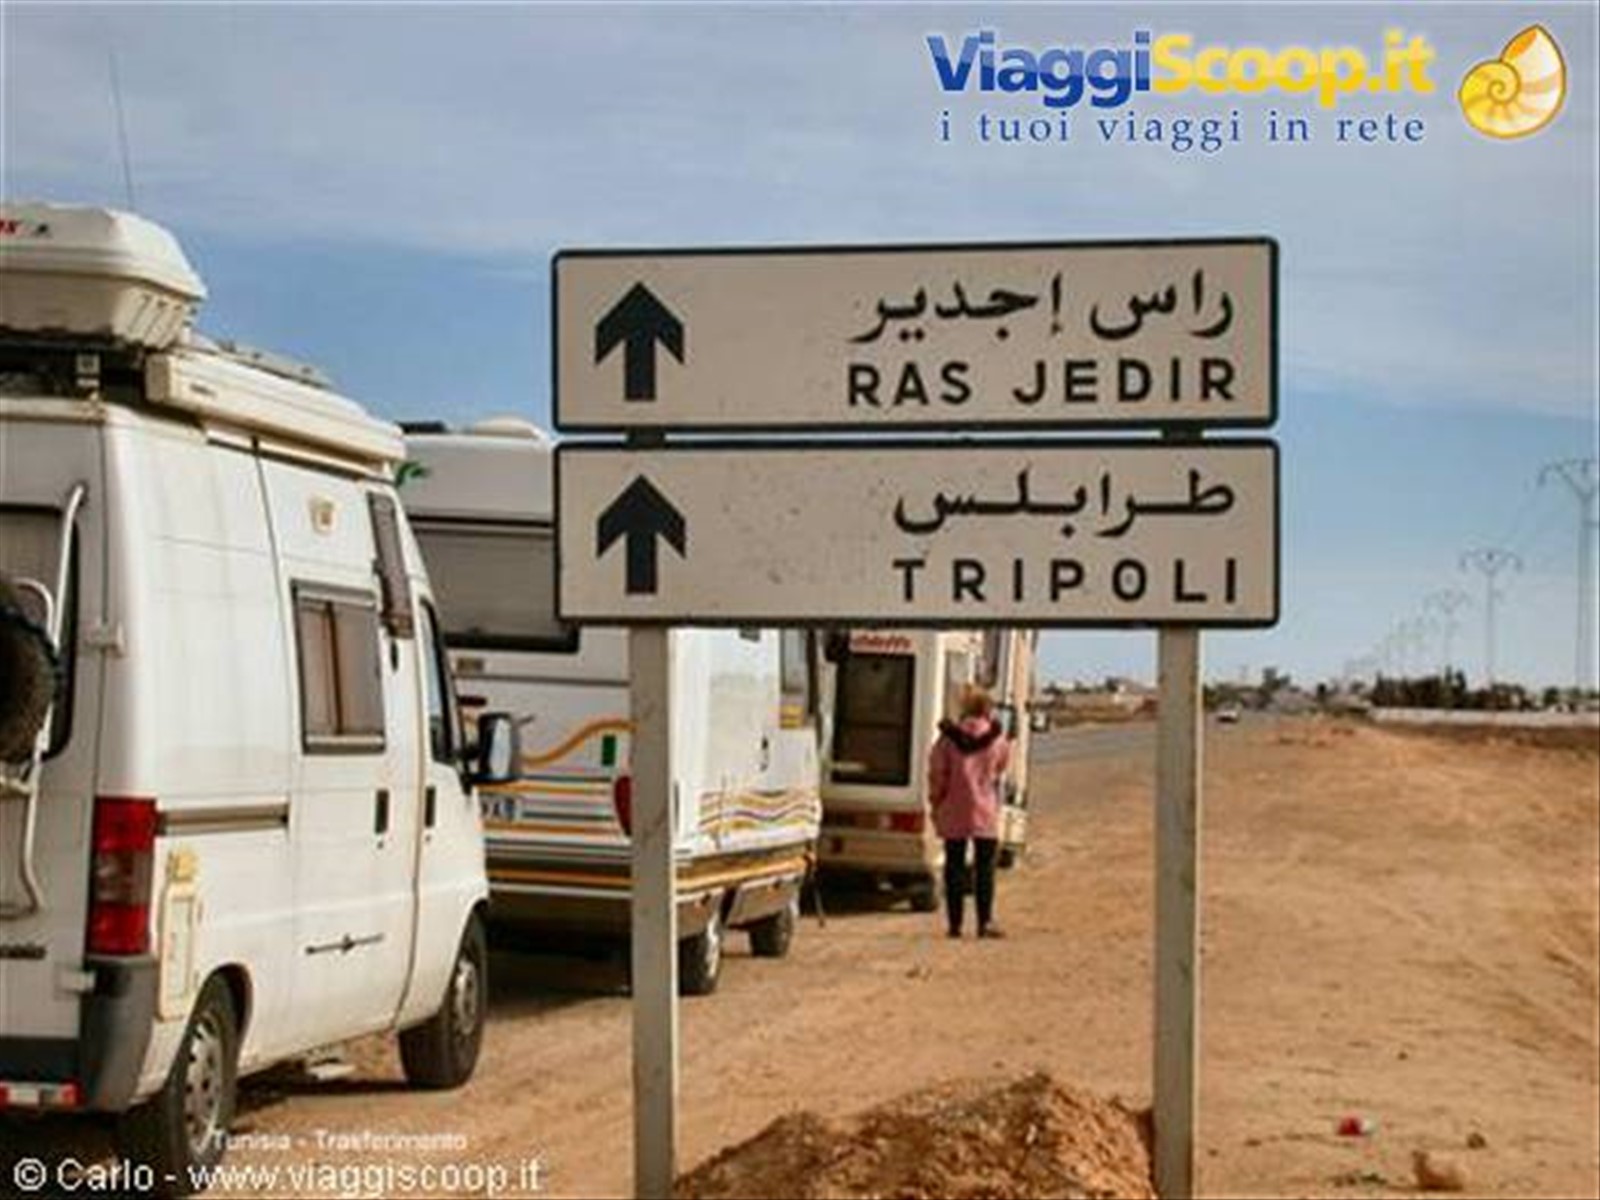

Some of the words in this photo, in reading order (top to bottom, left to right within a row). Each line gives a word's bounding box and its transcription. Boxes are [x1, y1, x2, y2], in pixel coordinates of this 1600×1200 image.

[849, 271, 1062, 342] إجدير
[1090, 268, 1233, 339] راس
[848, 361, 972, 406] RAS
[1012, 357, 1236, 404] JEDIR
[893, 465, 1236, 538] طرابلس
[893, 558, 1237, 602] TRIPOLI
